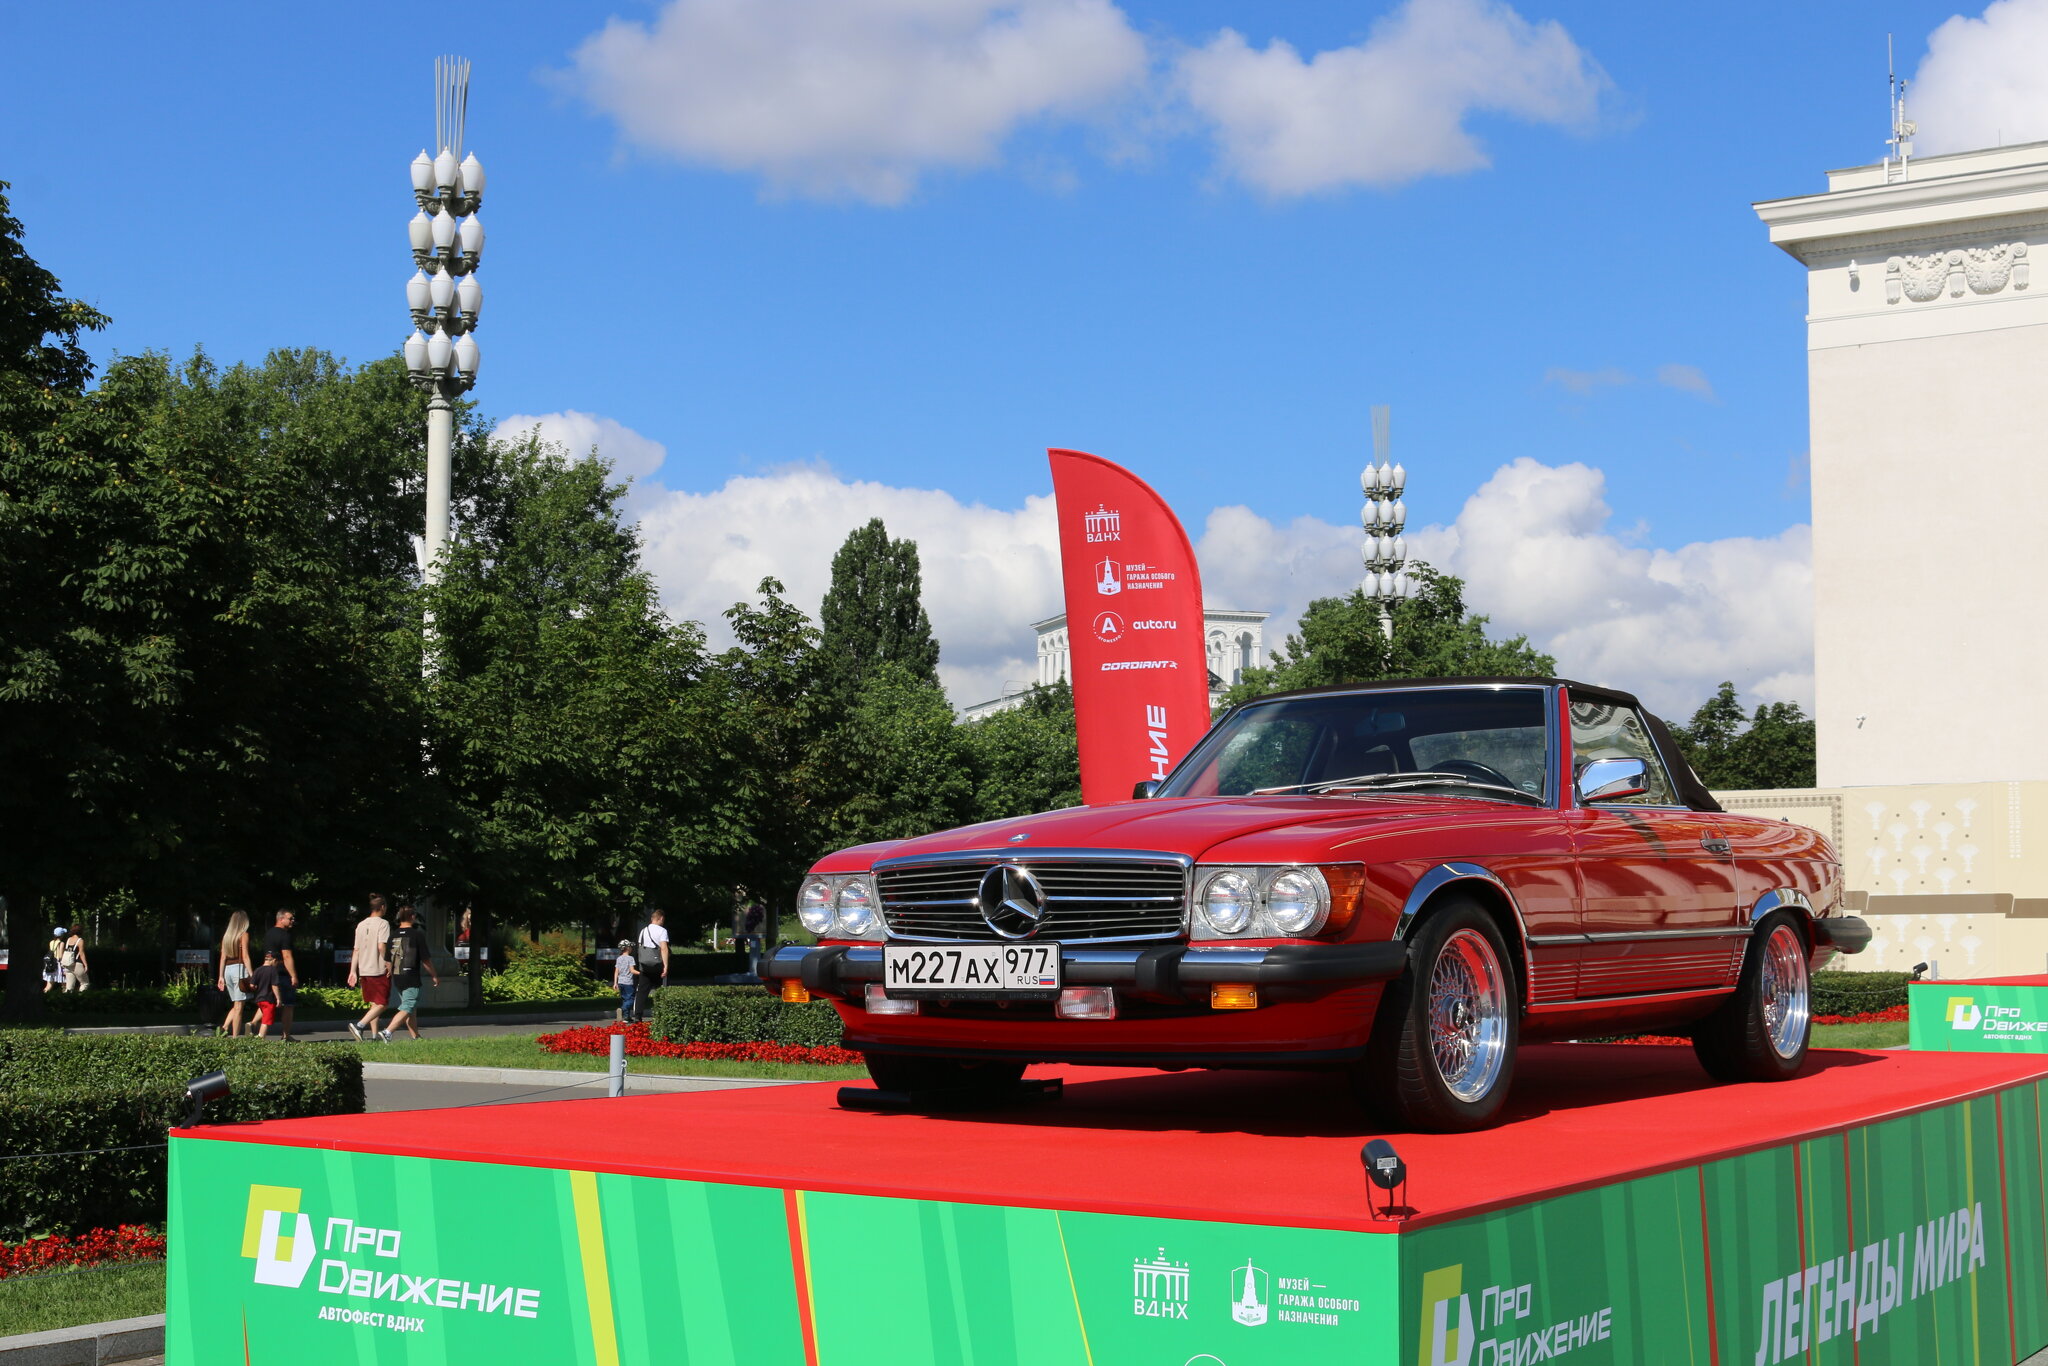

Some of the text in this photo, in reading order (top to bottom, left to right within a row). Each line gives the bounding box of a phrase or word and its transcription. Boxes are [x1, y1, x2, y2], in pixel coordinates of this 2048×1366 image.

[1086, 532, 1120, 543] ВДНХ
[1126, 563, 1146, 571] МУЗЕЙ
[1127, 582, 1163, 590] НАЗНАЧЕНИЯ
[1133, 619, 1176, 629] auto.ru
[892, 948, 1049, 984] М227АХ 977
[1017, 976, 1039, 985] RUS
[1278, 1277, 1310, 1291] МУЗЕЙ
[1755, 1201, 1986, 1366] ЛЕГЕНДЫ МИРА
[1133, 1298, 1189, 1320] ВДНХ
[1278, 1293, 1360, 1312] ГАРАЖА ОСОБОГО
[318, 1305, 425, 1333] АВТОФЕСТ ВДНХ
[1278, 1309, 1339, 1326] НАЗНАЧЕНИЯ
